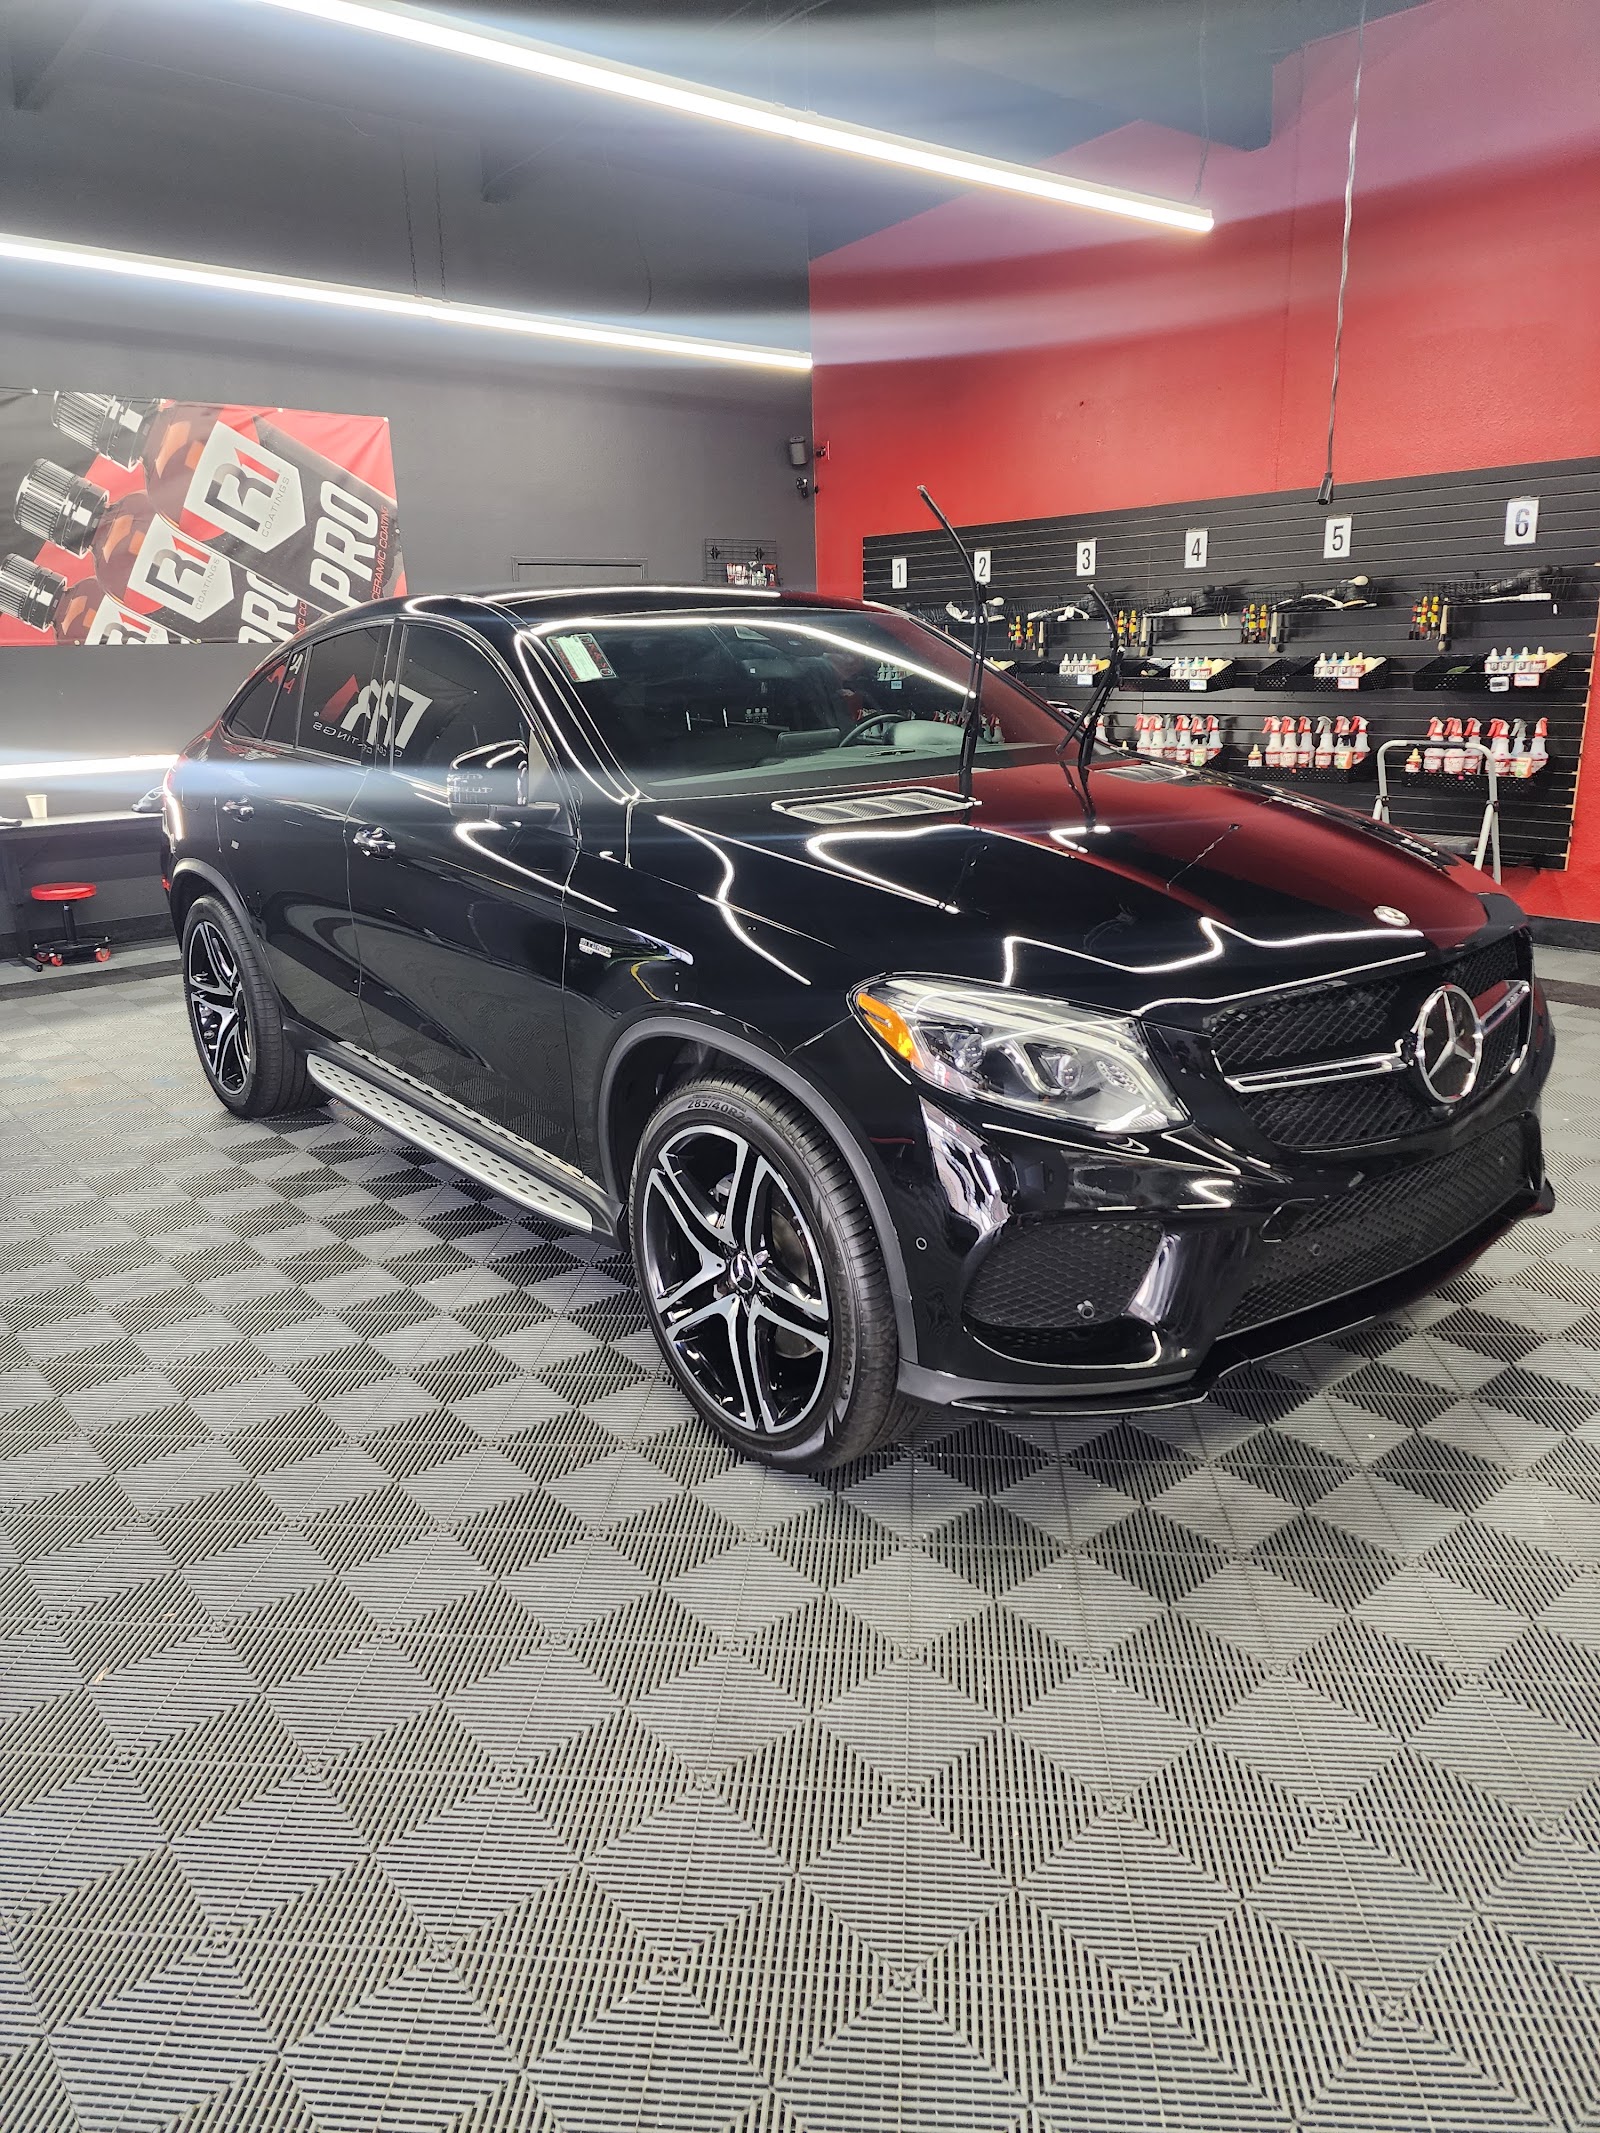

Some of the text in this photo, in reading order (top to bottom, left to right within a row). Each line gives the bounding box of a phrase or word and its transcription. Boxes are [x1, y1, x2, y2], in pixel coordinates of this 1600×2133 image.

[261, 476, 290, 538] COATINGS
[1515, 508, 1530, 537] 6
[309, 481, 378, 607] PRO
[1191, 538, 1202, 561] 4
[1332, 525, 1344, 551] 5
[979, 557, 987, 577] 2
[1082, 548, 1091, 570] 3
[195, 558, 219, 610] COATINGS
[371, 549, 386, 600] CERAMIC
[896, 564, 902, 583] 1
[687, 1099, 753, 1124] 285/40R22
